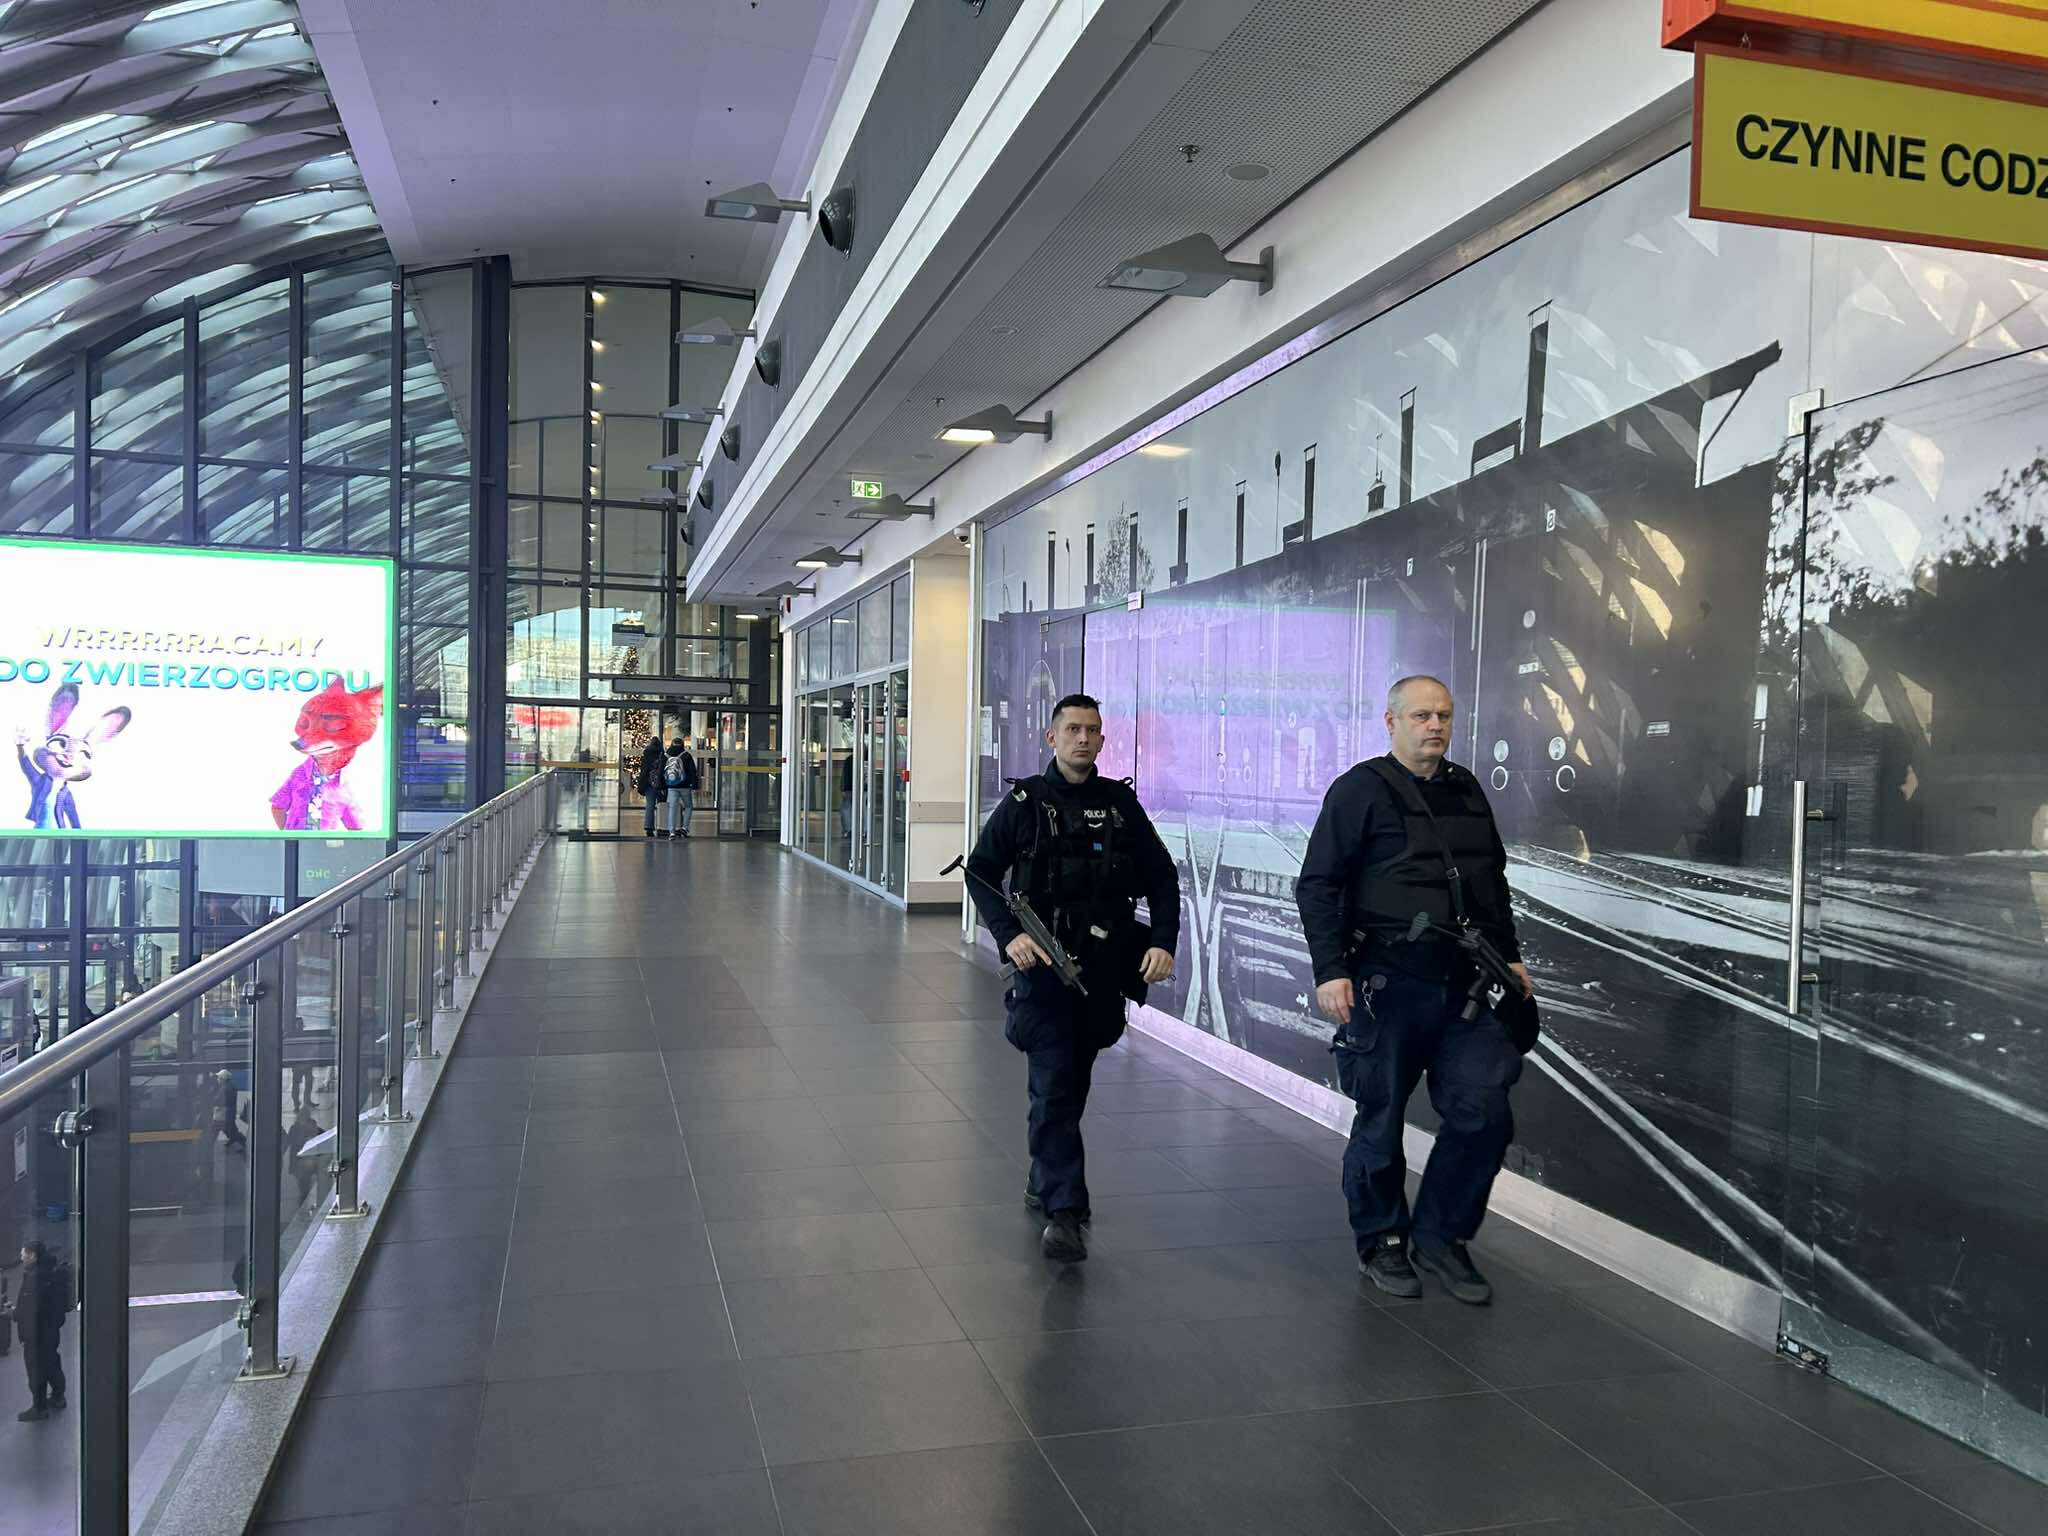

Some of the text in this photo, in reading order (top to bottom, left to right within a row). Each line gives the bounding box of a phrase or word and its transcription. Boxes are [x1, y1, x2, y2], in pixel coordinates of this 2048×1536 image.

[1735, 113, 1926, 182] CZYNNE
[39, 626, 324, 657] WRRRRRRACAMY
[62, 659, 370, 693] ZWIERZOGRODU
